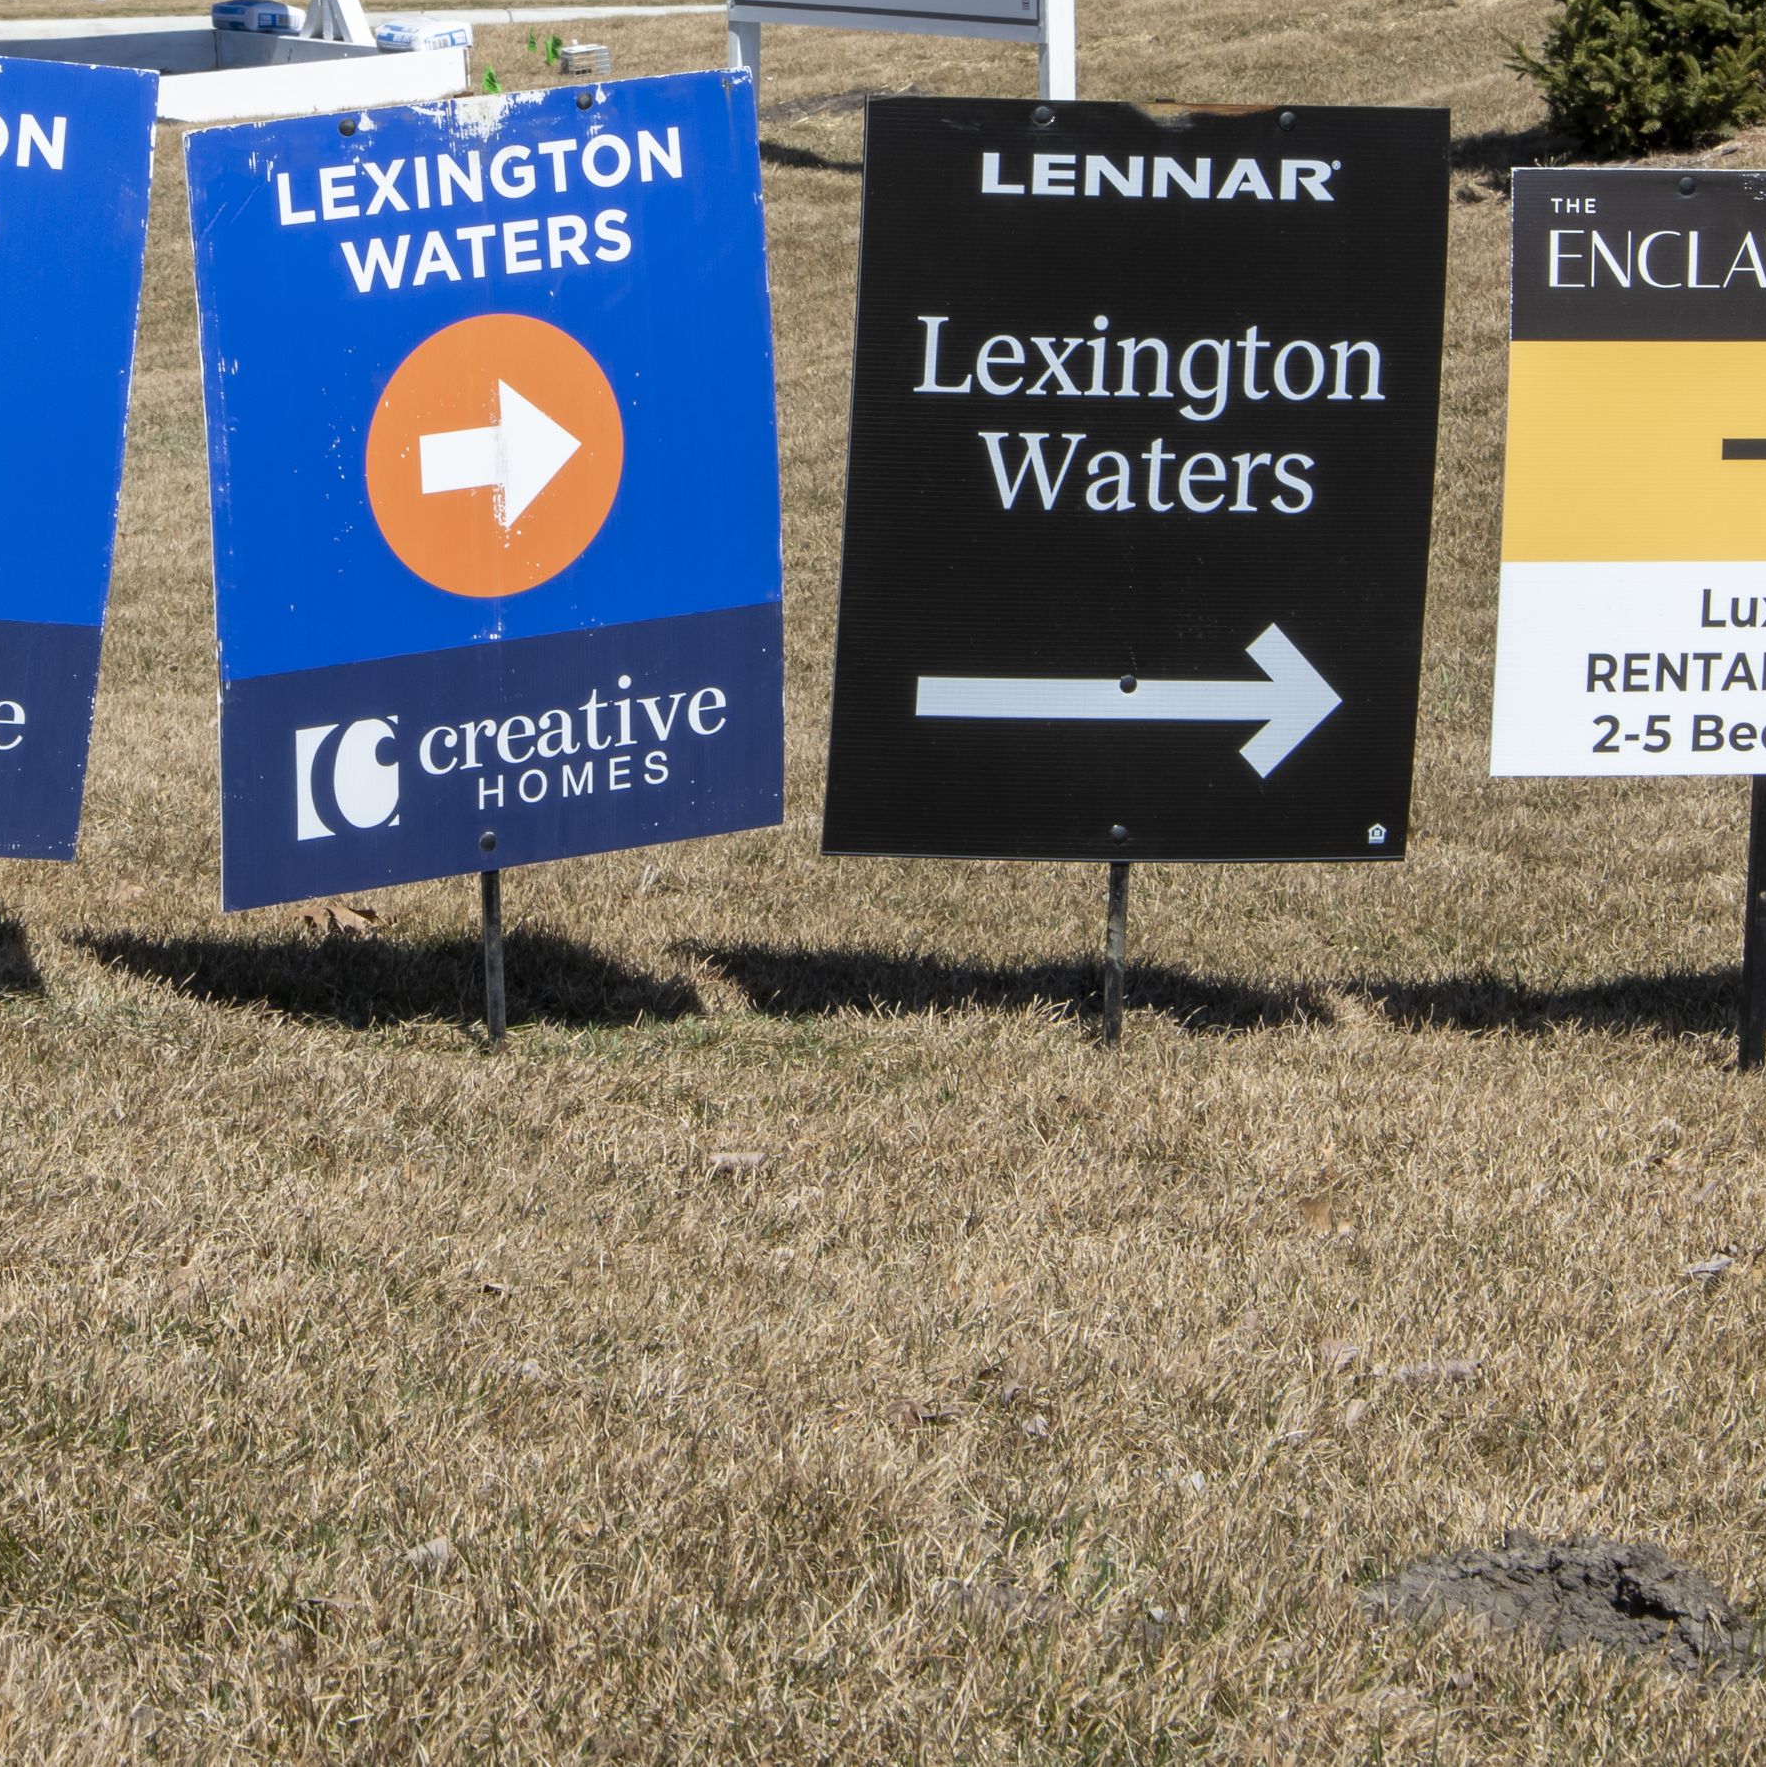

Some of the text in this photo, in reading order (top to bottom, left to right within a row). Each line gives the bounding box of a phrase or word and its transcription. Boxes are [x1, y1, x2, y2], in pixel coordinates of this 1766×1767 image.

[276, 126, 683, 226] LEXINGTON
[981, 152, 1334, 201] LENNAR
[1551, 198, 1597, 214] THE
[340, 209, 633, 293] WATERS
[913, 314, 1386, 421] Lexington
[978, 432, 1315, 514] Waters
[418, 674, 727, 775] creative
[1591, 714, 1672, 754] 2-5
[478, 750, 670, 811] HOMES
